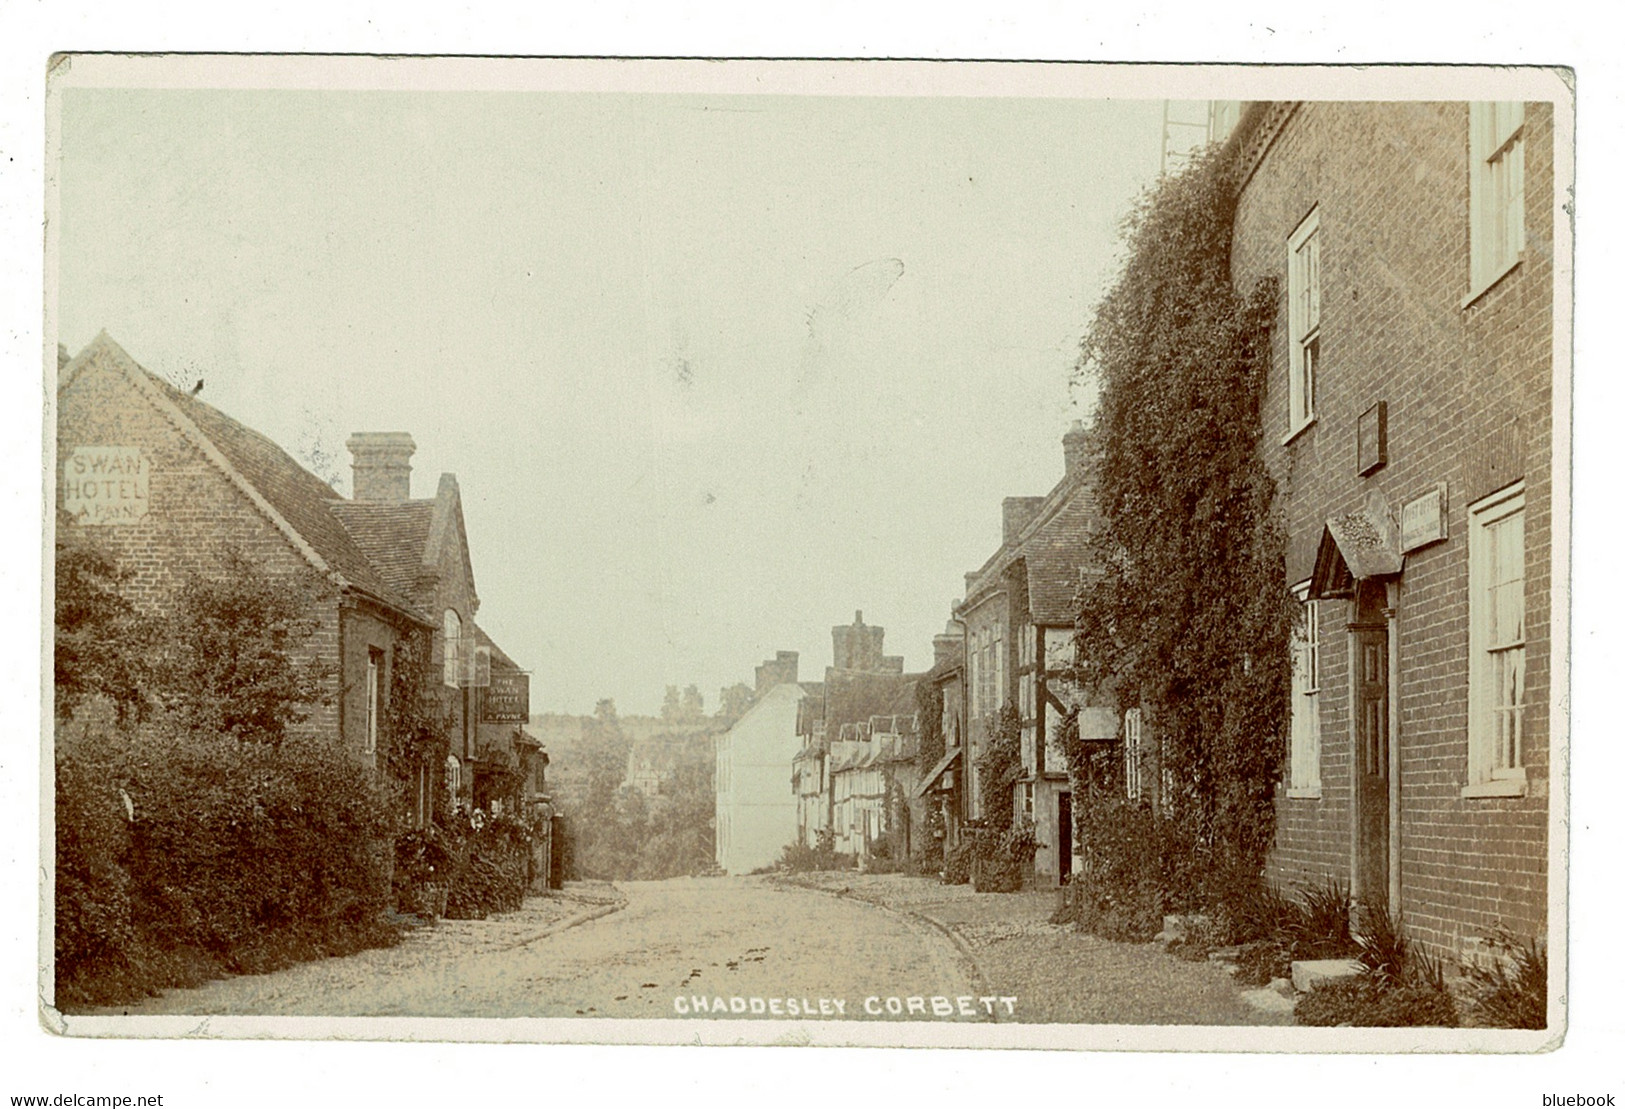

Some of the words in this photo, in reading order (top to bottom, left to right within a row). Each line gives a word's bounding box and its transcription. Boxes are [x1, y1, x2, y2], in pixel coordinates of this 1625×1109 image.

[73, 454, 140, 474] SWAN
[65, 479, 146, 500] HOTEL
[78, 503, 89, 517] A
[1404, 502, 1419, 524] POST
[490, 687, 519, 695] SWAN
